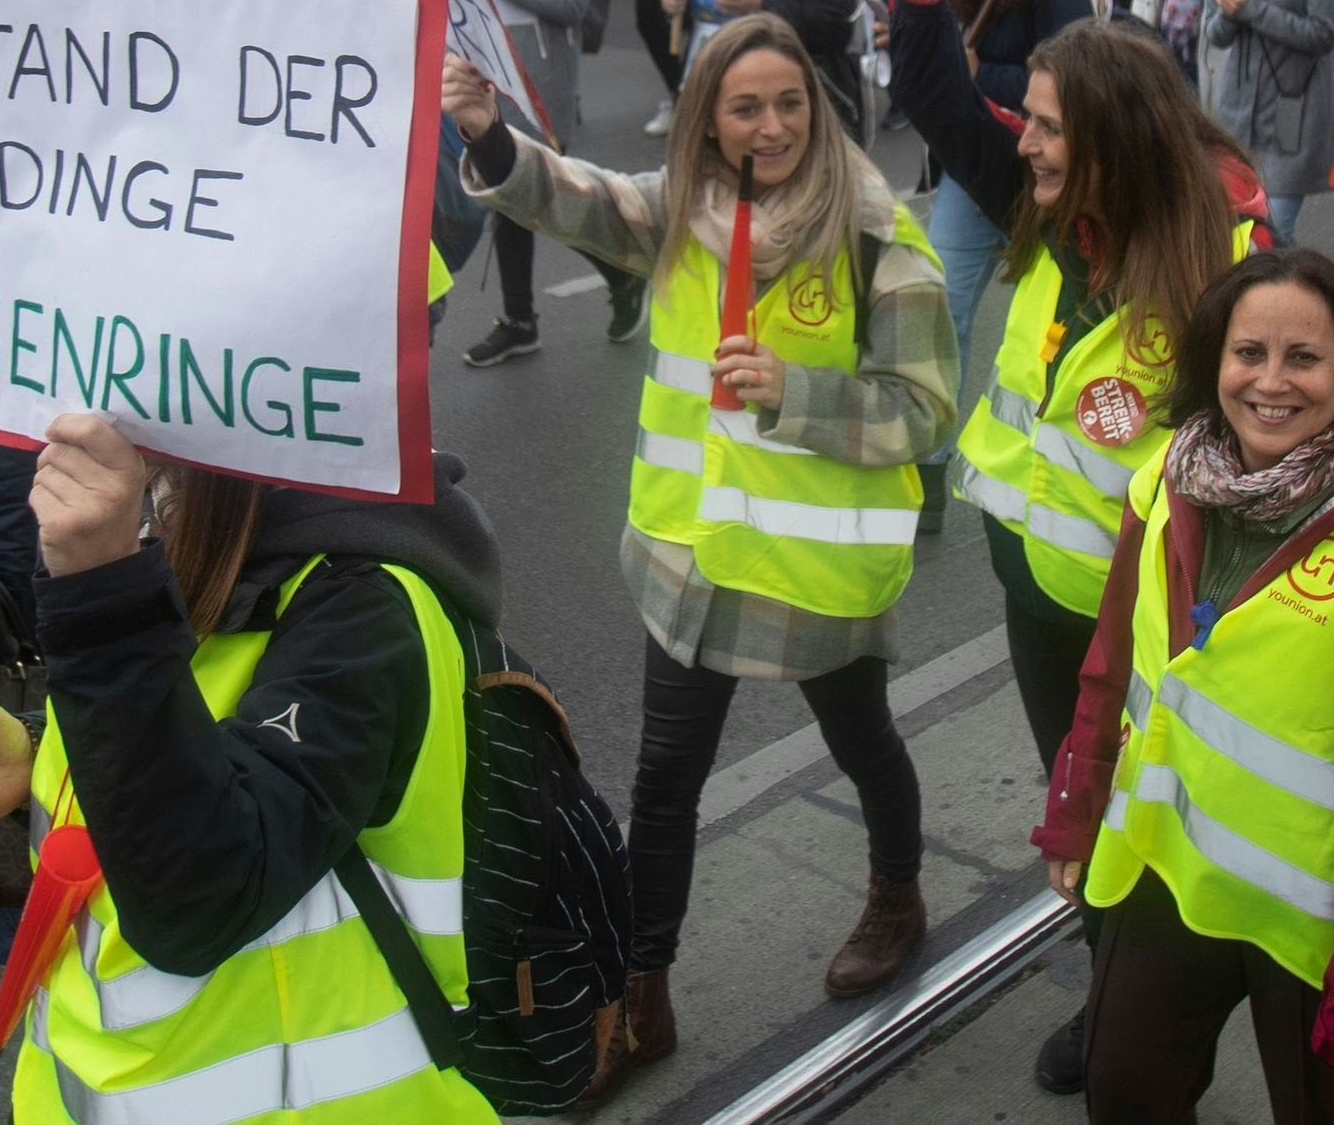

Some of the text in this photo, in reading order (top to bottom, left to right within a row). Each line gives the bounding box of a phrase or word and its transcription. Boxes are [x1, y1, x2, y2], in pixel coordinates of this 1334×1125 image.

[238, 45, 379, 148] DER
[1091, 385, 1120, 440] BEREIT
[1267, 588, 1329, 627] younion.at
